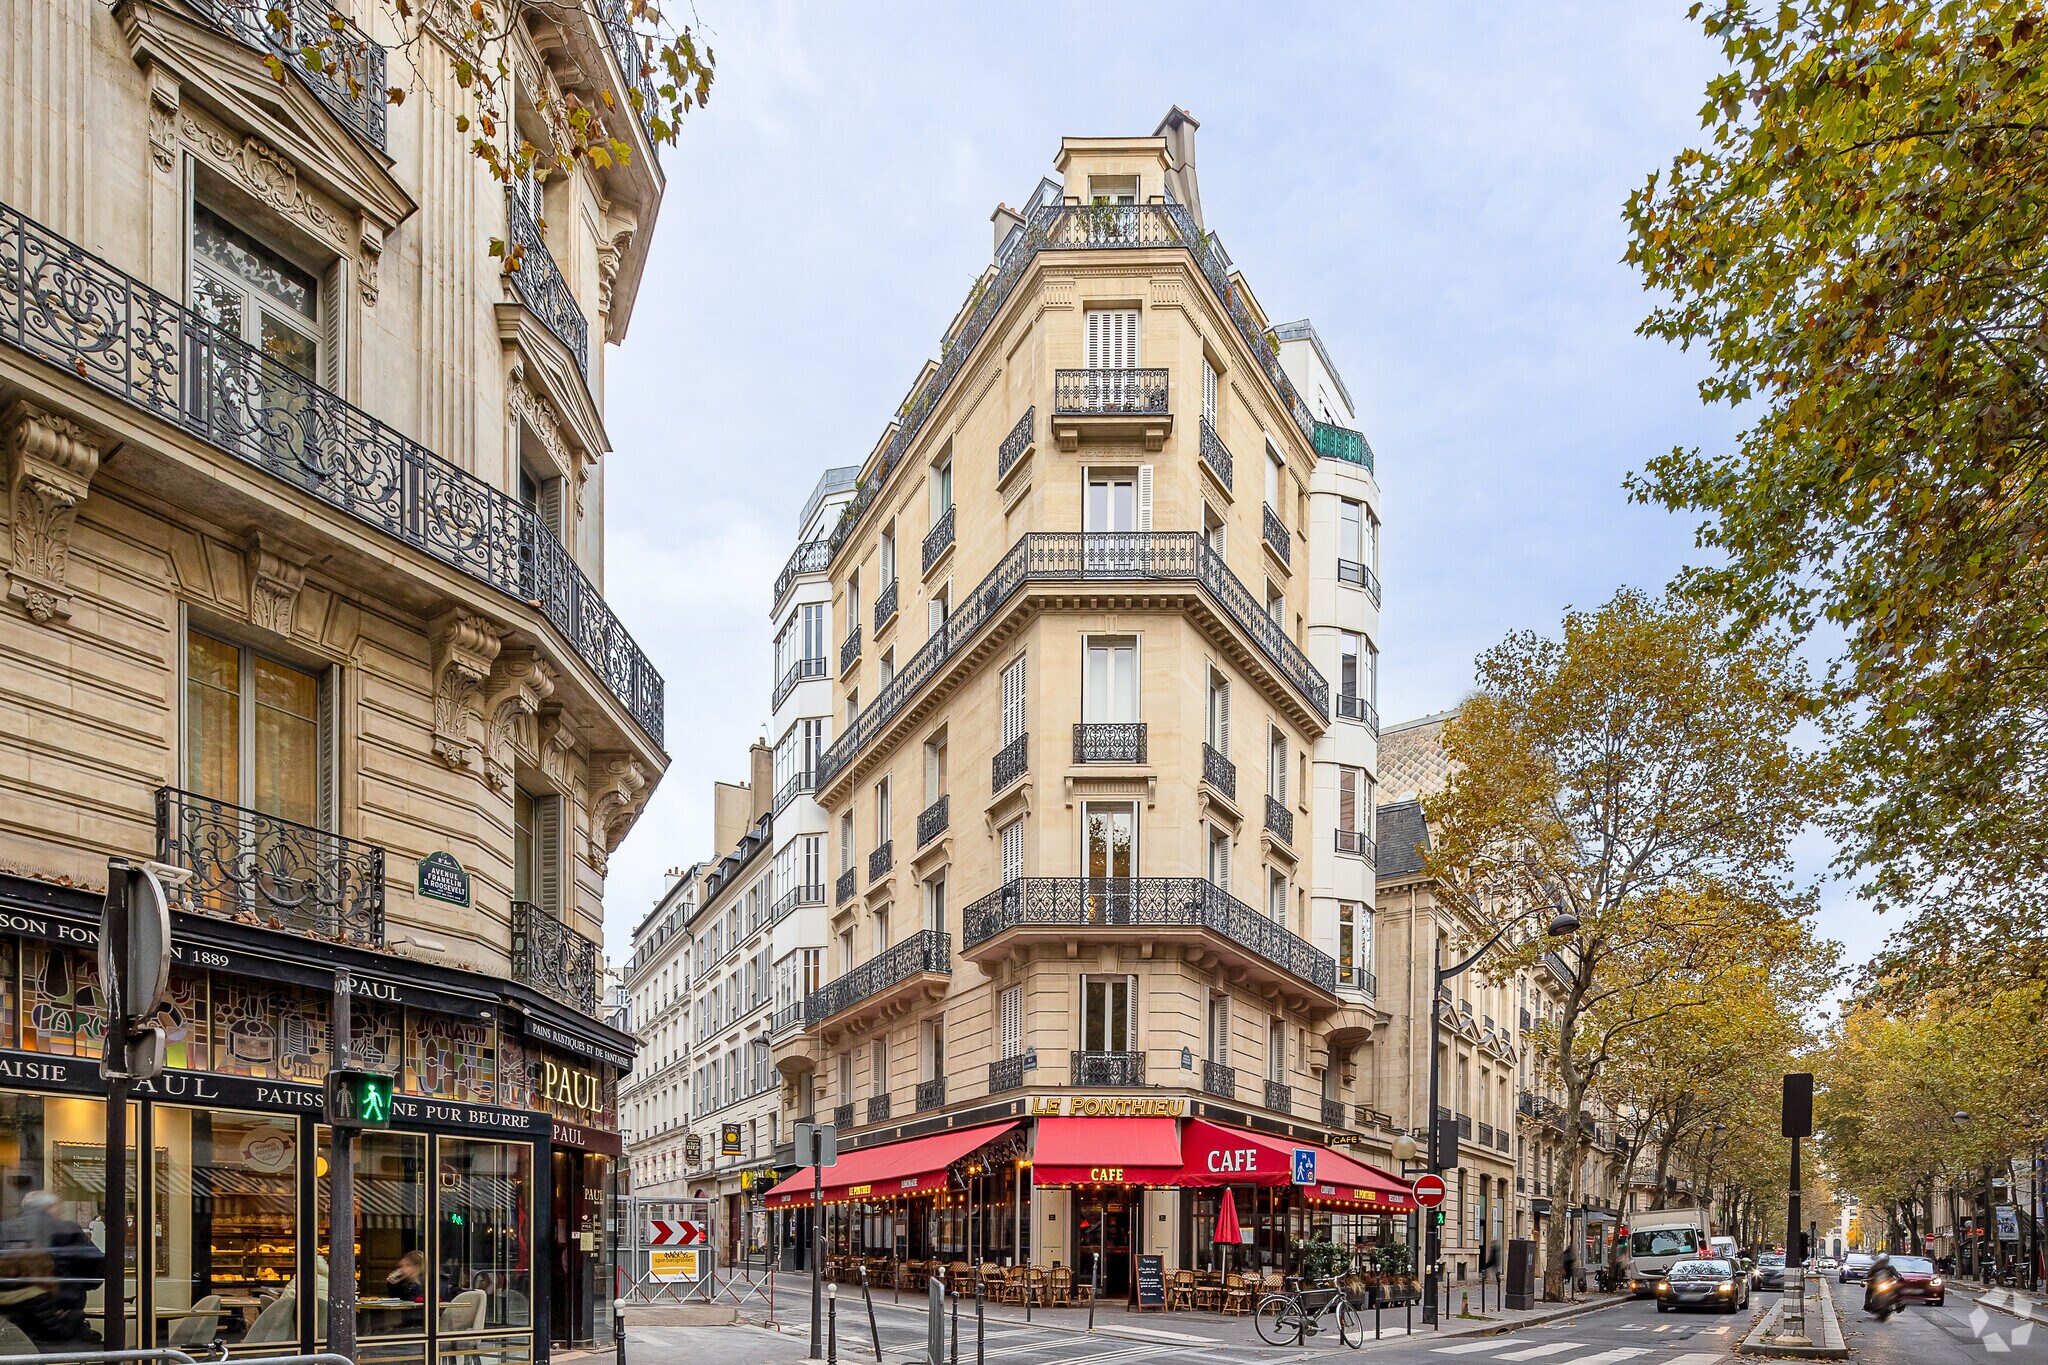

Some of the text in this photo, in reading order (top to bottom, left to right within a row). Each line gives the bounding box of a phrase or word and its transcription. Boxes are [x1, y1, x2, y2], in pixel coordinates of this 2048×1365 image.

[427, 872, 462, 887] FRANKLIN
[431, 867, 459, 880] AVENUE
[430, 880, 466, 896] ROOSEVELT
[193, 950, 229, 967] 1889
[349, 977, 403, 1002] PAUL
[532, 1022, 629, 1068] PAINS RUSTIQUES ET DE FANTAISIE
[0, 1060, 67, 1083] AISIE
[544, 1061, 604, 1113] PAUL
[1031, 1096, 1185, 1116] LE PONTHIEU
[425, 1105, 462, 1122] PUR
[468, 1109, 530, 1129] BEURRE
[553, 1124, 585, 1146] PAUL
[1333, 1136, 1357, 1144] CAFE
[1207, 1149, 1257, 1173] CAFE
[1090, 1168, 1124, 1181] CAFE
[584, 1188, 604, 1201] PAUL
